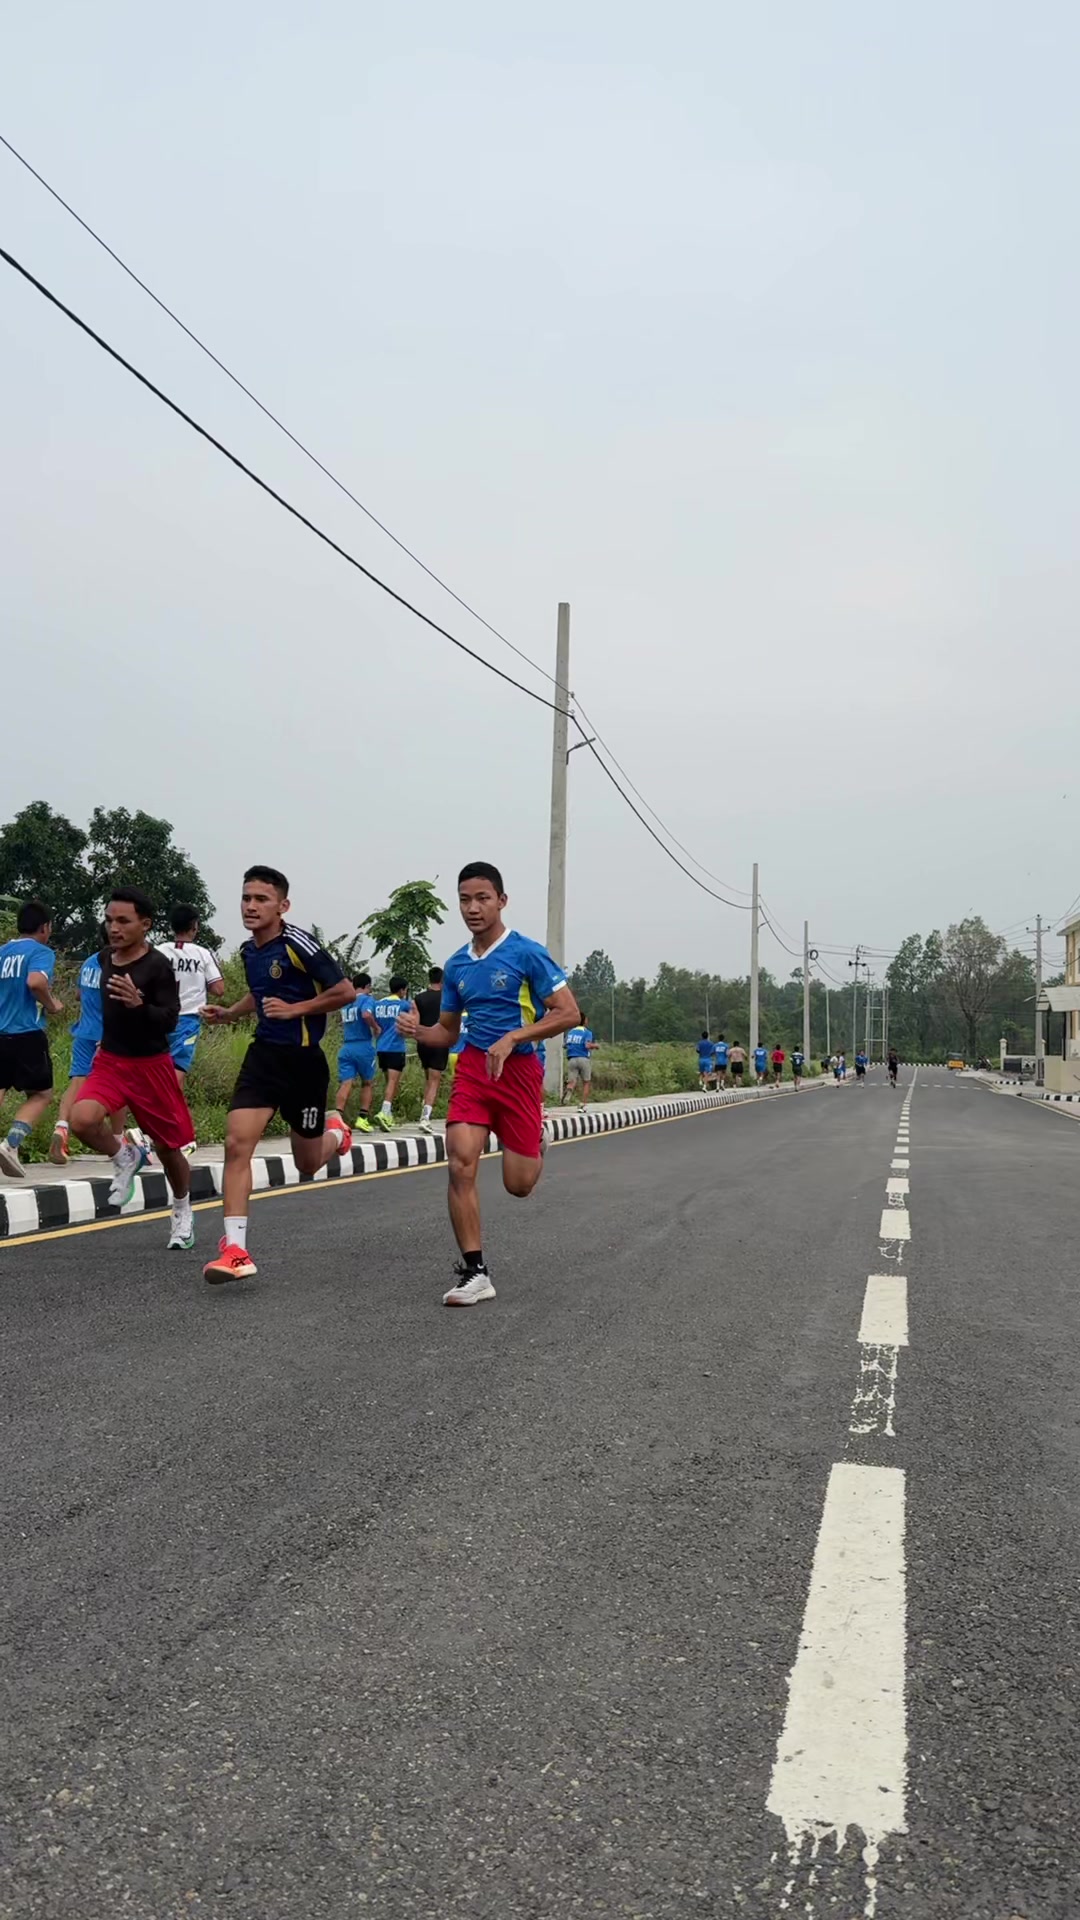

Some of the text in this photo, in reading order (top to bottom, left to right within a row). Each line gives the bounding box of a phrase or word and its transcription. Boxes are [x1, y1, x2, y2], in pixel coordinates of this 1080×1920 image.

[0, 954, 25, 979] AXY
[375, 1005, 401, 1019] GALAXY
[301, 1107, 318, 1129] 10
